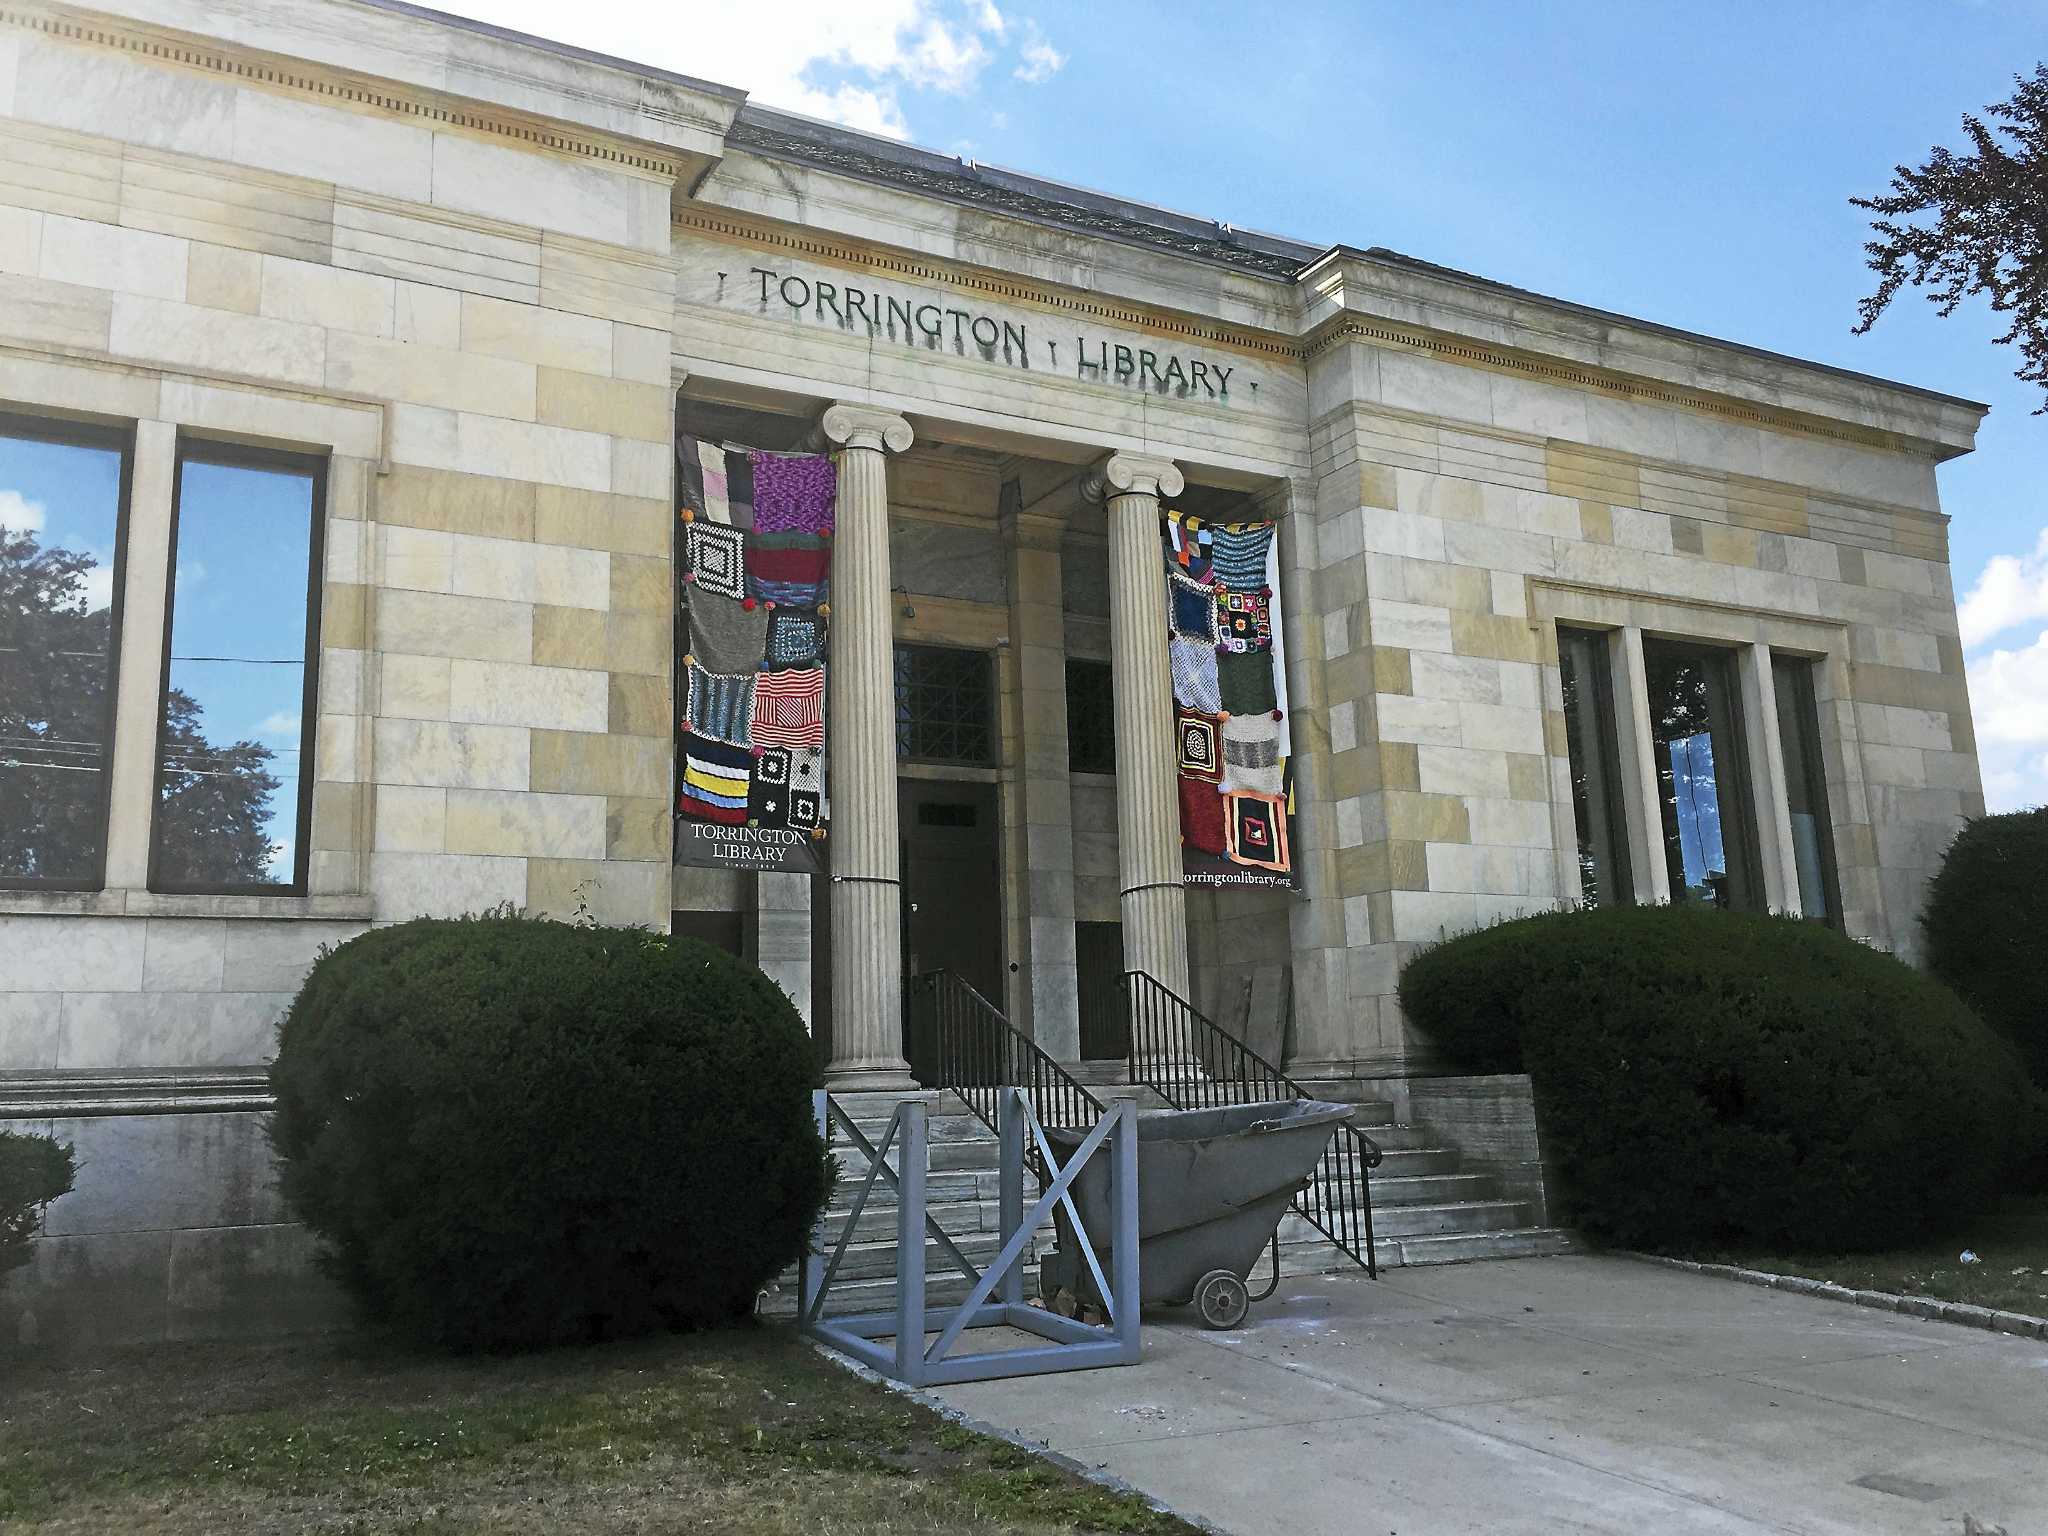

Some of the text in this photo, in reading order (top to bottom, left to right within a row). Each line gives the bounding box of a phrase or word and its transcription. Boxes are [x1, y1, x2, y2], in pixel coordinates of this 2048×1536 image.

[751, 266, 1234, 394] TORRINGTON LIBRARY
[690, 823, 807, 846] TORRINGTON
[712, 843, 787, 862] LIBRARY
[1182, 871, 1292, 888] orringtonlibrary.org
